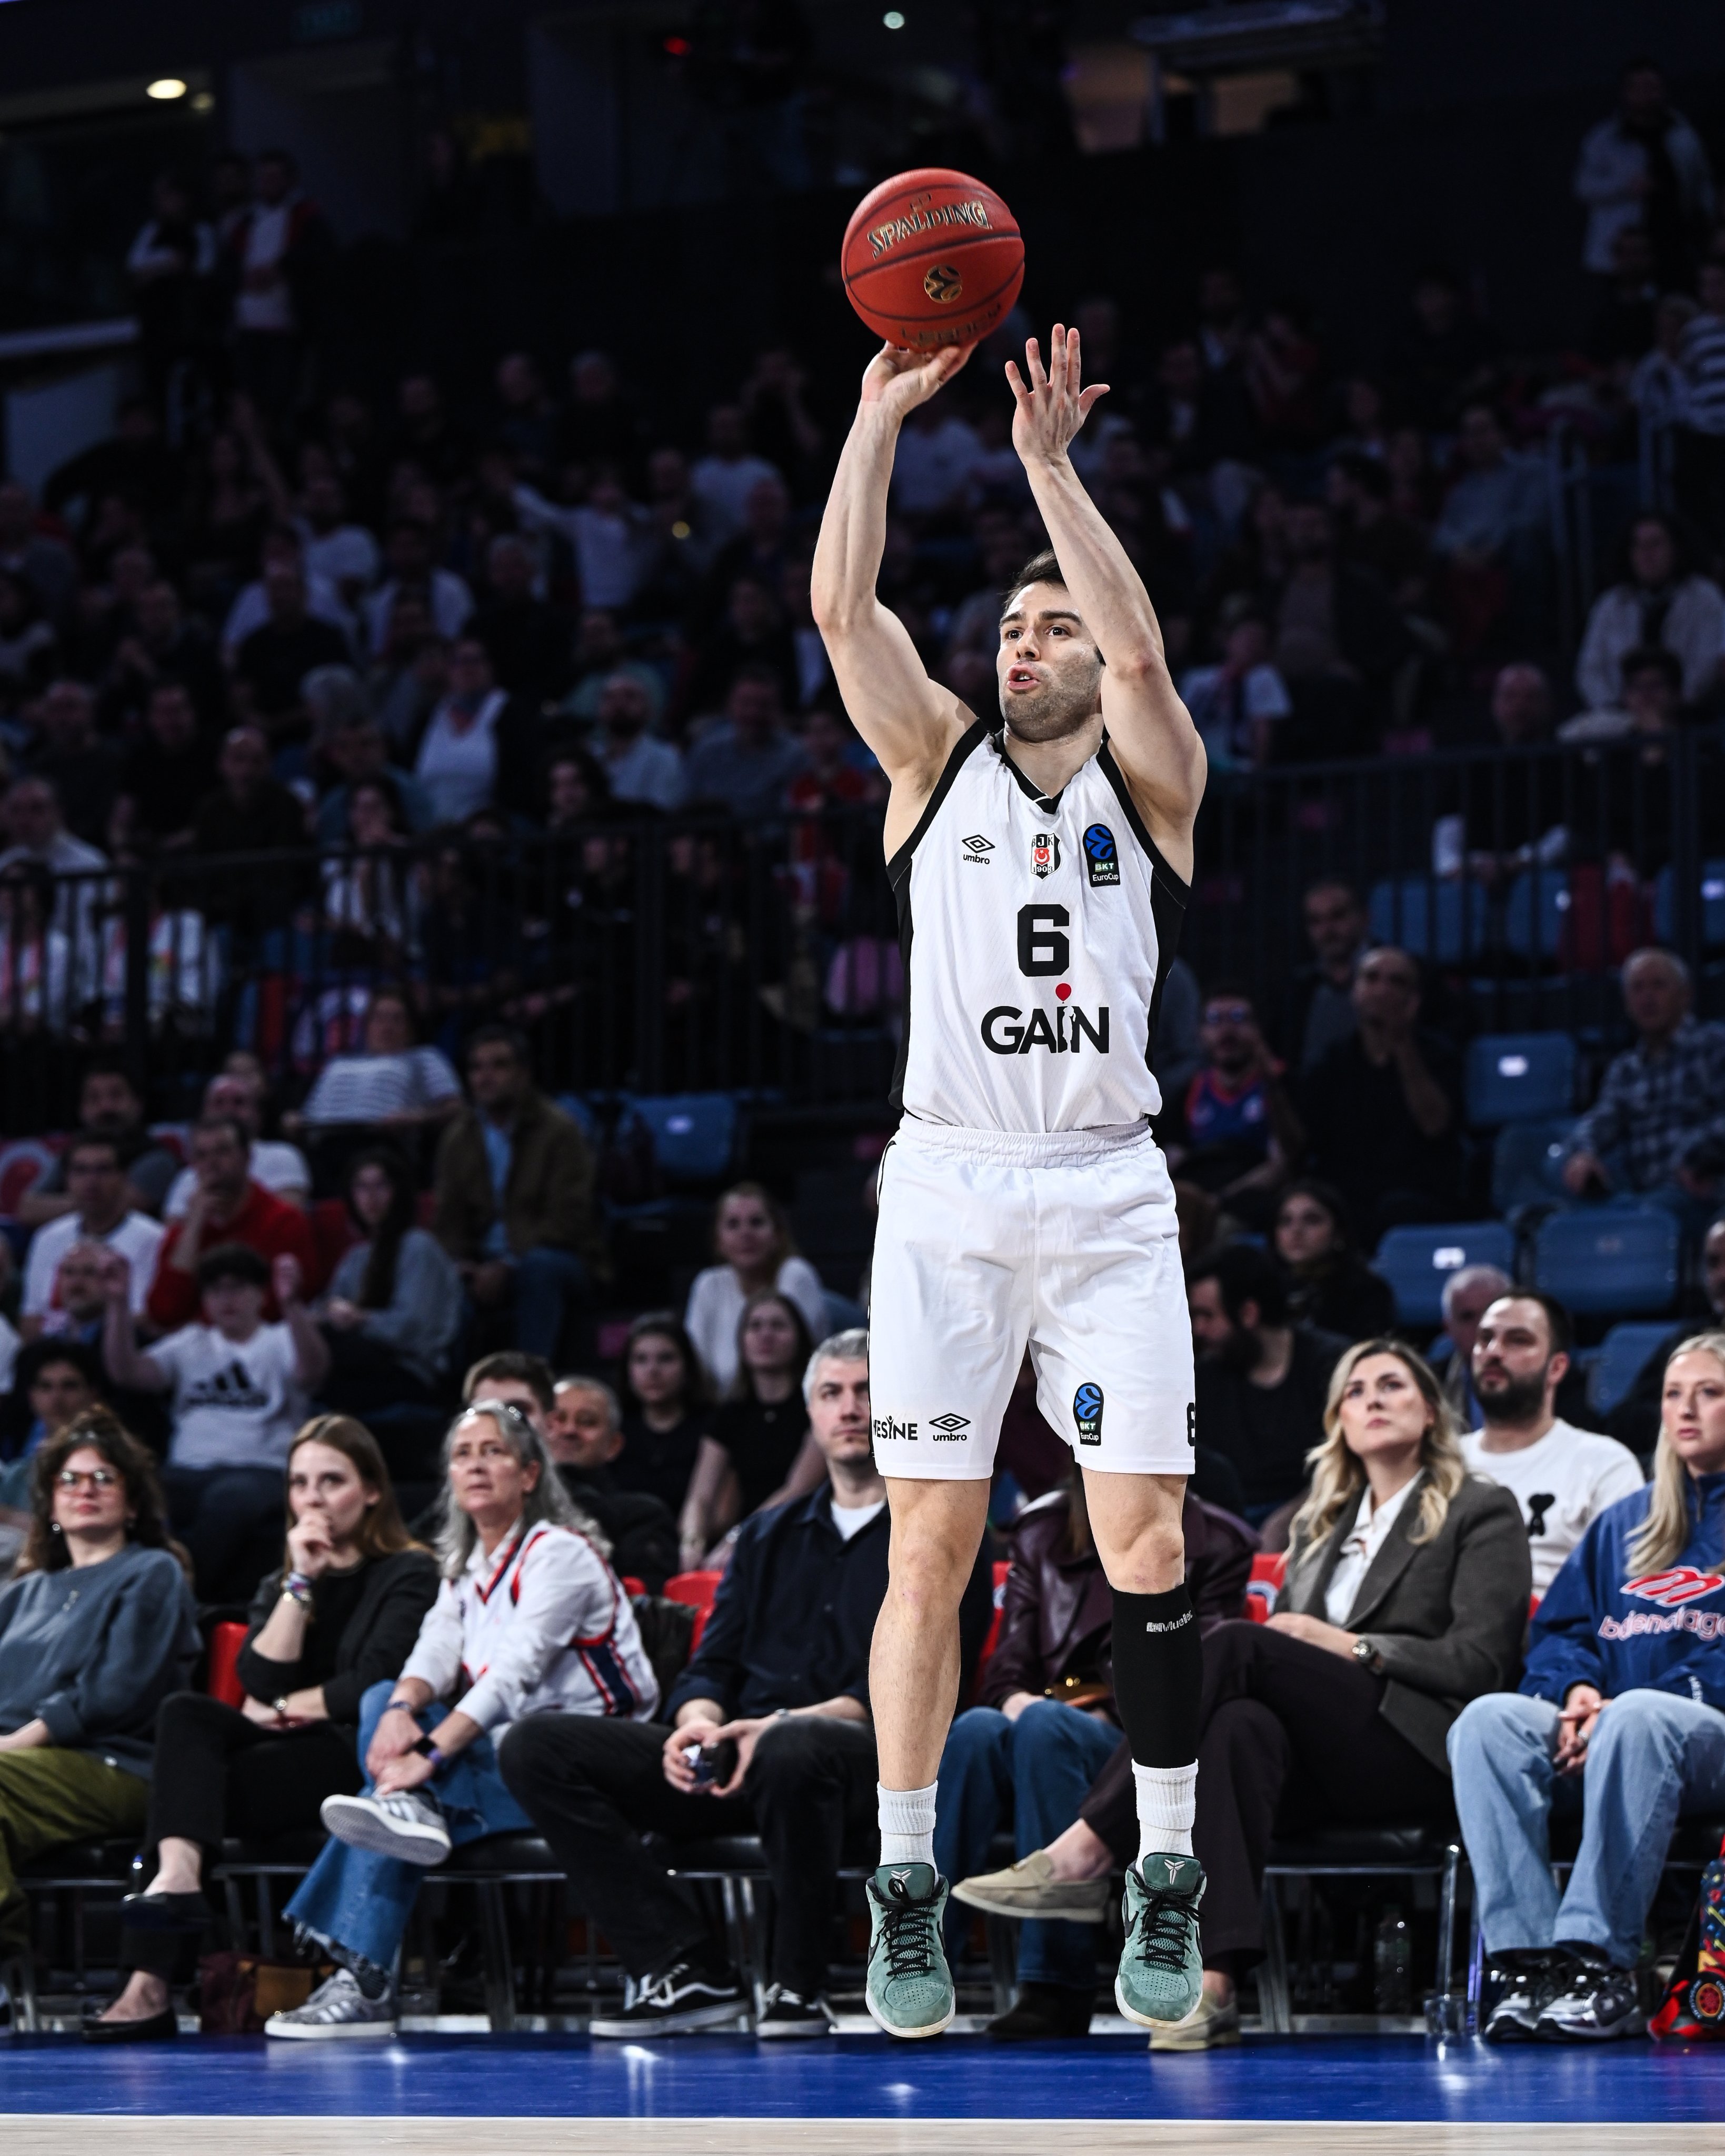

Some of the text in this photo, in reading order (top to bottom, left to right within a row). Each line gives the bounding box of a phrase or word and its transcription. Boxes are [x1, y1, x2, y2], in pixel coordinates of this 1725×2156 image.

[867, 200, 993, 261] SPALDING
[1032, 836, 1053, 847] BJK
[963, 853, 990, 865] umbro
[1094, 862, 1114, 872] BKT
[1092, 873, 1119, 882] EuroCup
[1017, 904, 1070, 977] 6
[1080, 1421, 1096, 1431] BKT
[933, 1433, 967, 1441] umbro
[1080, 1432, 1099, 1442] EuroCup
